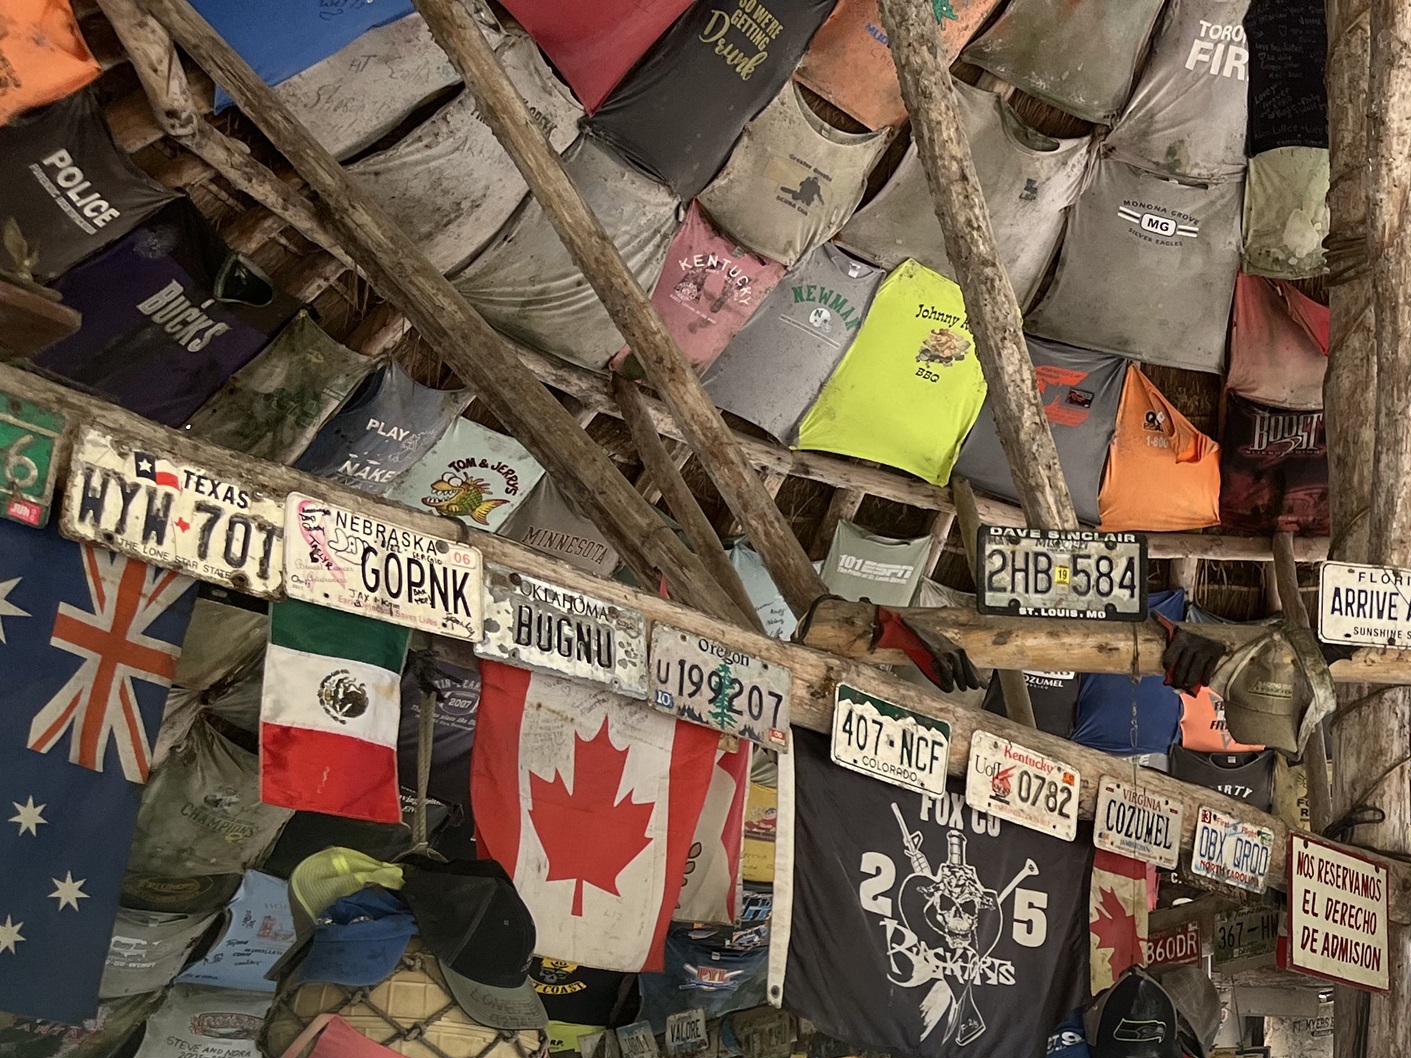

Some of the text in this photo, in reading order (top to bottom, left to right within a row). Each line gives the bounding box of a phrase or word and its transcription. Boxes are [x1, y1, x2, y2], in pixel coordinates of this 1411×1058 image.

[699, 9, 768, 81] Drunk
[730, 9, 770, 51] GETTING
[42, 149, 120, 229] POLICE
[1124, 200, 1200, 226] MONONA GROVE
[1147, 218, 1170, 232] MG
[1128, 227, 1183, 247] SILVER EAGLES
[678, 252, 752, 307] KENTUCKY
[137, 279, 233, 354] BUCKS
[791, 284, 861, 332] NEWMAN
[916, 303, 960, 329] Johnny
[915, 367, 940, 384] BBQ
[366, 418, 410, 442] PLAY
[448, 457, 489, 473] TOM &
[79, 468, 176, 547] WYW
[183, 468, 249, 510] TEXAS
[336, 510, 438, 557] NEBRASKA
[523, 525, 609, 567] MINNESOTA
[990, 527, 1136, 543] DAVE SINCLAIR
[117, 537, 233, 581] THE LONE STAR STATE
[987, 549, 1137, 599] 2HB 584
[361, 544, 473, 619] GOPNK
[453, 551, 471, 566] 06
[520, 579, 609, 623] OKLAHOMA
[1330, 587, 1398, 622] ARRIVE
[515, 605, 614, 669] BUGNU
[699, 638, 750, 668] Oregon
[1353, 626, 1403, 640] SUNSHINE
[840, 711, 945, 786] 407 NCF
[861, 754, 918, 784] COLORADO
[1003, 743, 1055, 776] Kentucky
[919, 791, 965, 831] FOX
[1017, 769, 1072, 820] 0782
[1121, 788, 1163, 812] VIRGINIA
[1105, 799, 1174, 851] COZUMEL
[1200, 859, 1226, 875] NORTH
[1296, 850, 1382, 902] NOS RESERVAMOS
[860, 850, 1048, 948] 2 5
[1302, 889, 1377, 936] EL DERECHO
[1300, 925, 1382, 972] DE ADMISION
[541, 980, 587, 995] COAST
[166, 1036, 252, 1058] STEVE AND NORA
